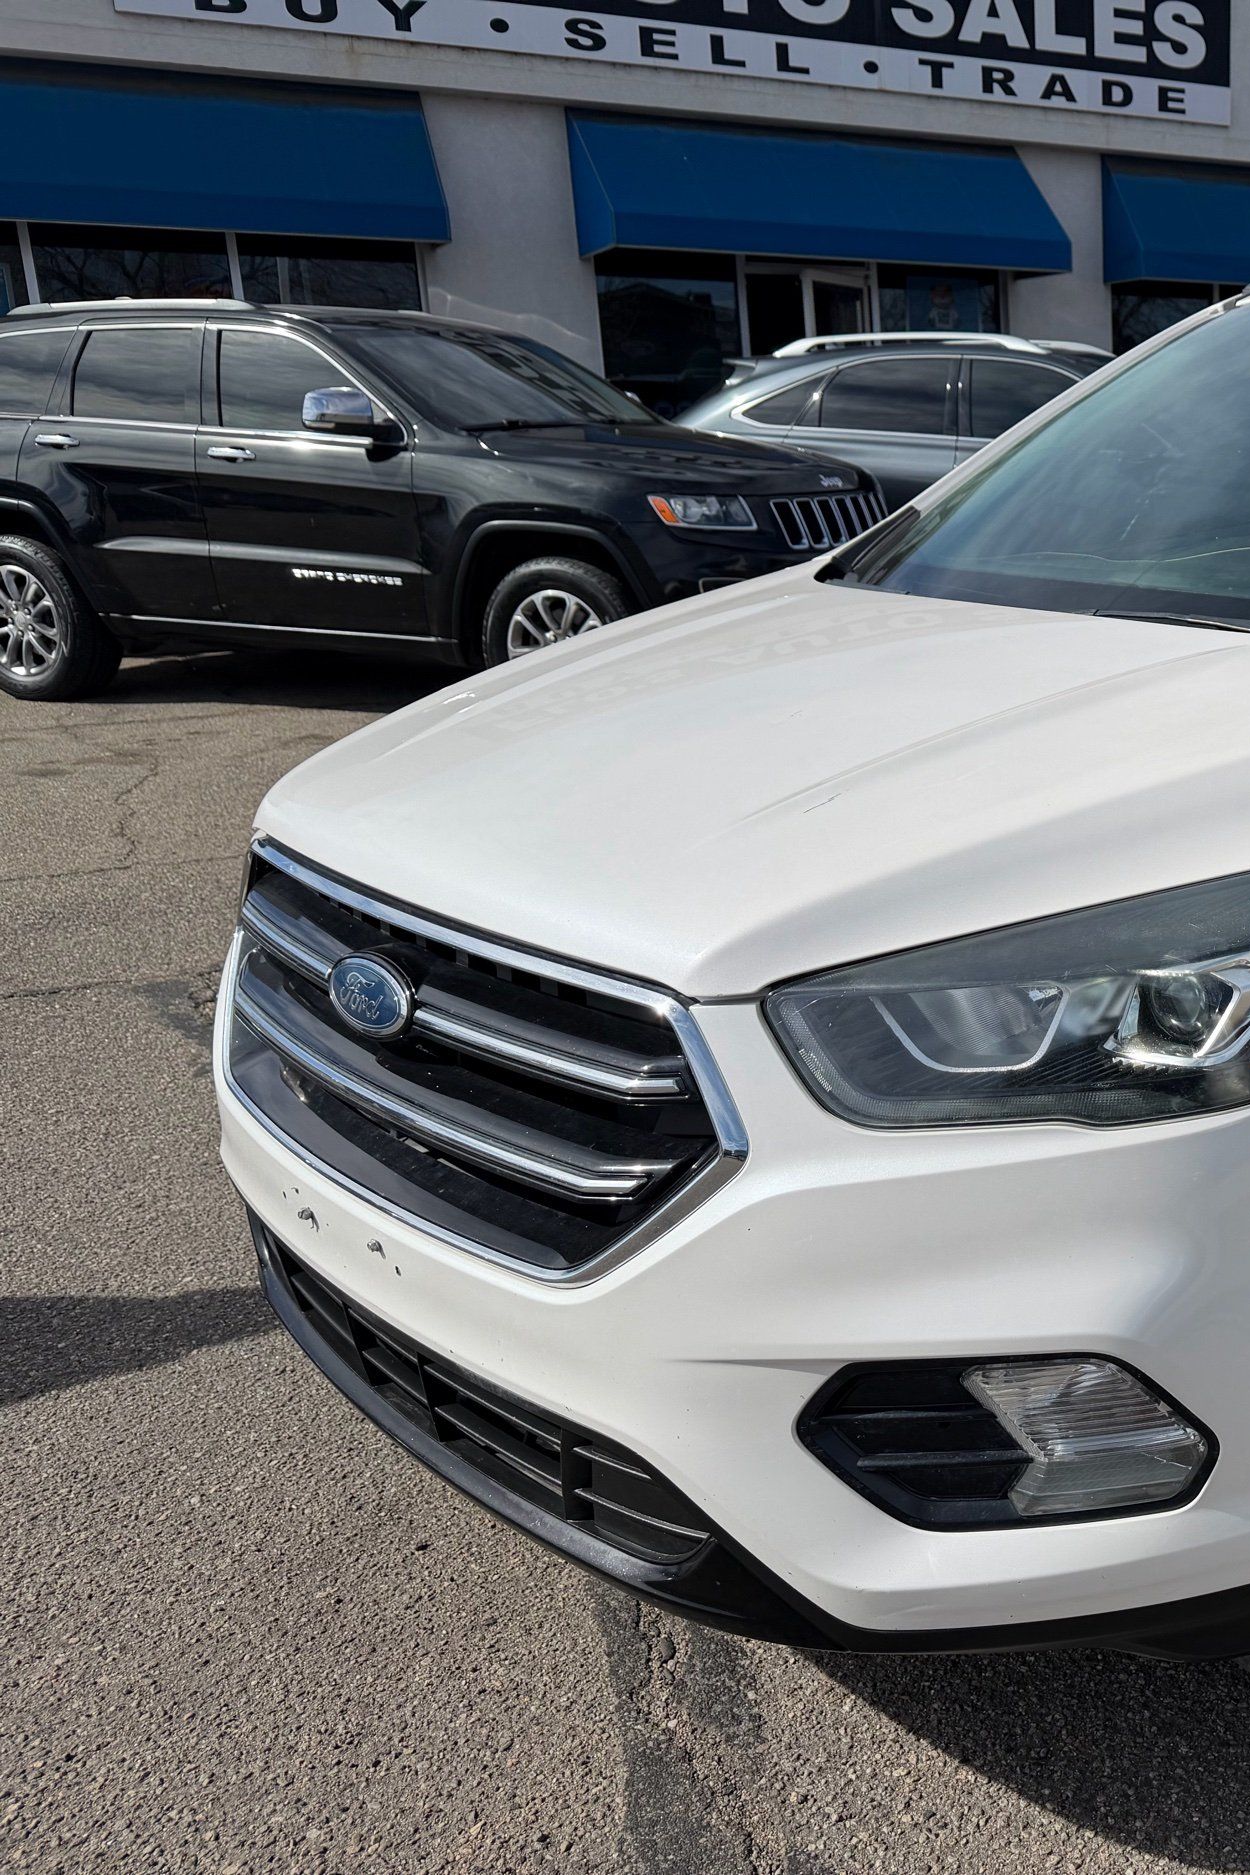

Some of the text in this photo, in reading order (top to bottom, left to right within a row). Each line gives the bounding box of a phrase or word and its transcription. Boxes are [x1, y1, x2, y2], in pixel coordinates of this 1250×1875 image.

[564, 17, 811, 75] SELL
[917, 57, 1187, 115] TRADE
[891, 0, 1207, 70] SALES
[339, 972, 383, 1020] Ford
